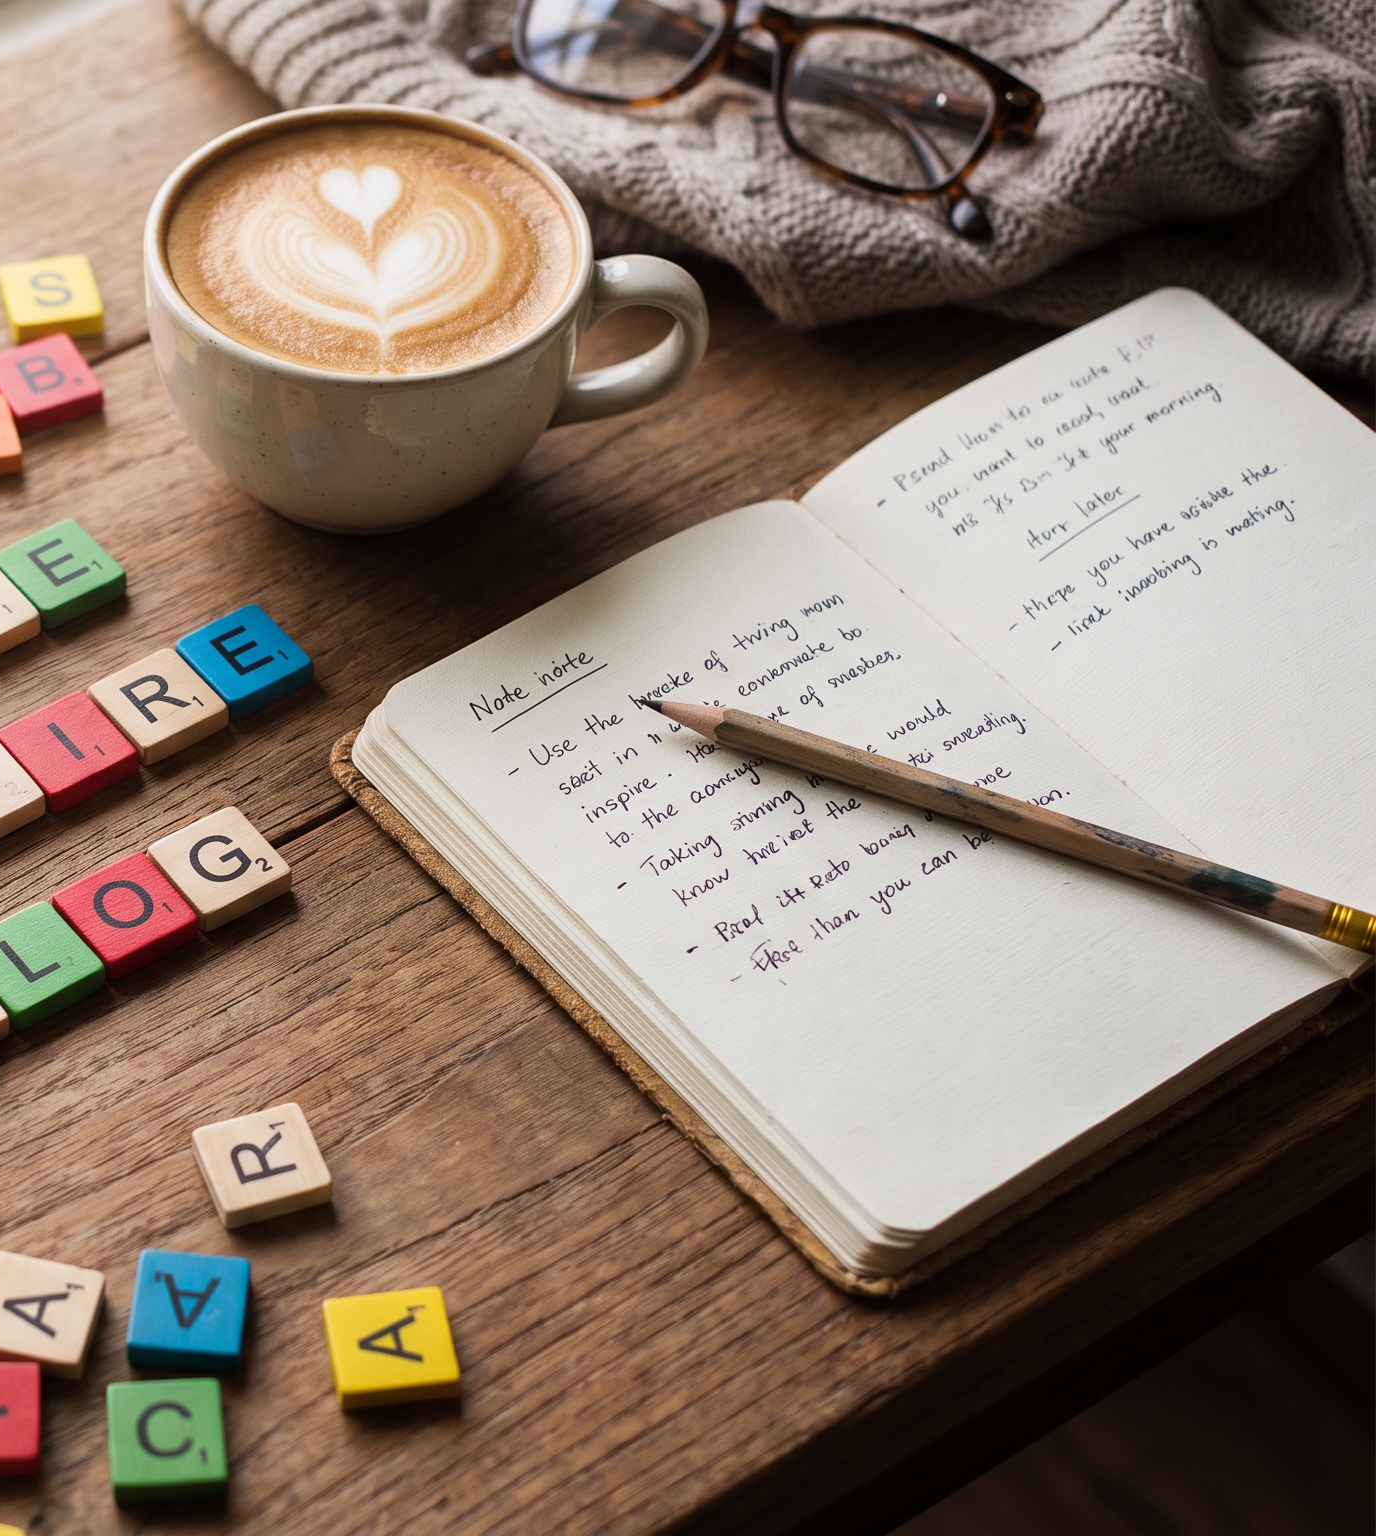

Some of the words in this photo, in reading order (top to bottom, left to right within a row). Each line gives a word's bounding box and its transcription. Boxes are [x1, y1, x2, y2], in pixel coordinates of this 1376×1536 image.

[30, 272, 73, 307] S
[16, 355, 66, 394] B
[1025, 436, 1045, 450] to
[1100, 422, 1136, 454] your
[1073, 486, 1125, 517] later
[1088, 553, 1125, 587] you
[1126, 522, 1175, 550] have
[1241, 464, 1278, 486] the
[1199, 537, 1218, 551] is
[277, 649, 289, 661] 1
[469, 684, 530, 721] Note
[528, 738, 578, 766] Use
[584, 712, 624, 736] the
[704, 650, 728, 673] of
[799, 685, 825, 707] of
[612, 747, 639, 766] in
[641, 802, 679, 829] the
[887, 698, 952, 740] would
[255, 857, 273, 873] 2
[639, 834, 723, 876] Taking
[672, 868, 730, 907] know
[826, 798, 862, 819] the
[810, 908, 860, 942] than
[869, 878, 912, 916] you
[921, 850, 958, 876] can
[231, 1132, 297, 1184] R
[3, 1291, 70, 1339] A
[164, 1273, 221, 1329] A
[357, 1313, 425, 1364] A
[136, 1401, 194, 1459] C
